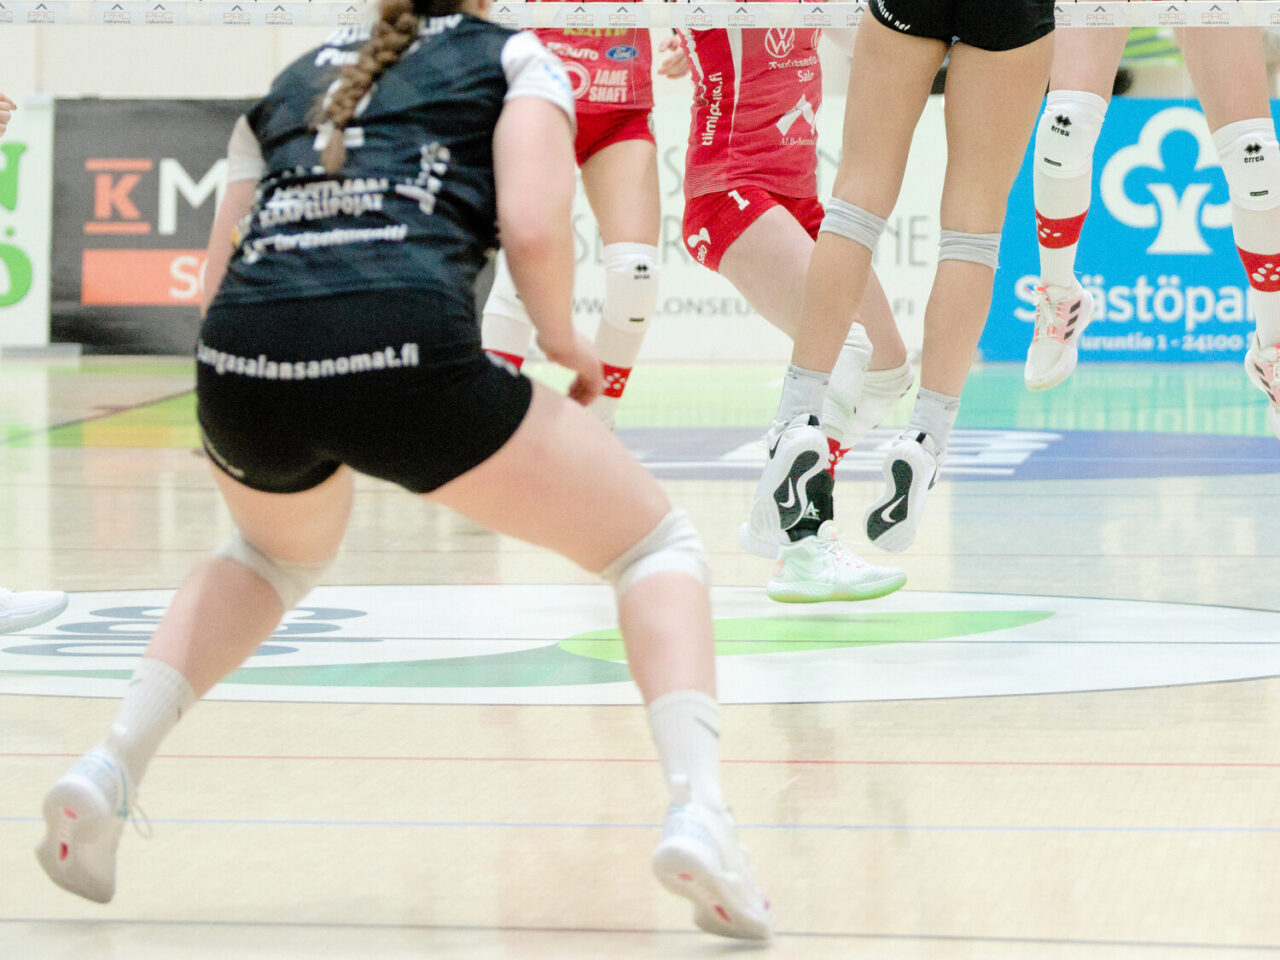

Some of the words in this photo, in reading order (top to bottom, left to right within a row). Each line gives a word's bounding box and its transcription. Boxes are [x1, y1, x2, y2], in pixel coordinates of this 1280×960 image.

[594, 69, 628, 86] JAME
[589, 85, 628, 103] SHAFT
[727, 188, 749, 211] 1
